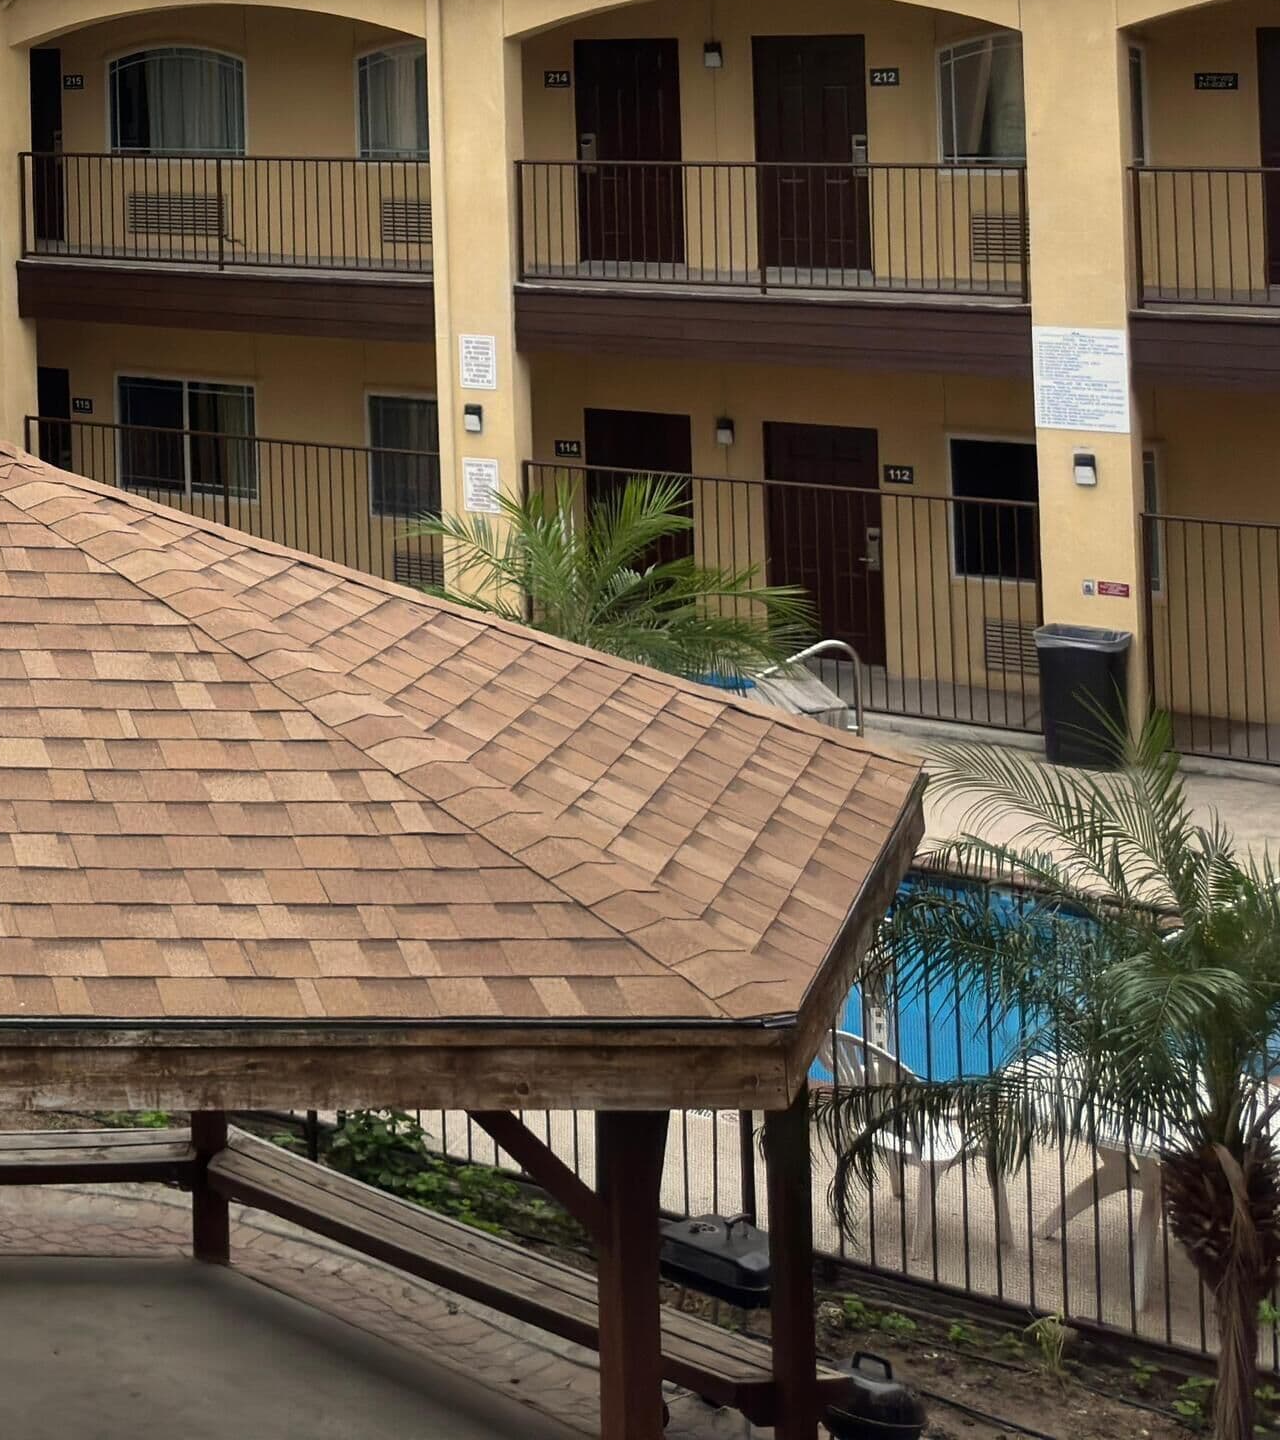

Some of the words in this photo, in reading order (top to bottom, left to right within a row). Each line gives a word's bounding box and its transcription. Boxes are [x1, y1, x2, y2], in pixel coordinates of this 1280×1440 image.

[547, 72, 568, 83] 214
[873, 71, 896, 83] 212
[559, 441, 578, 453] 114
[888, 468, 911, 481] 112
